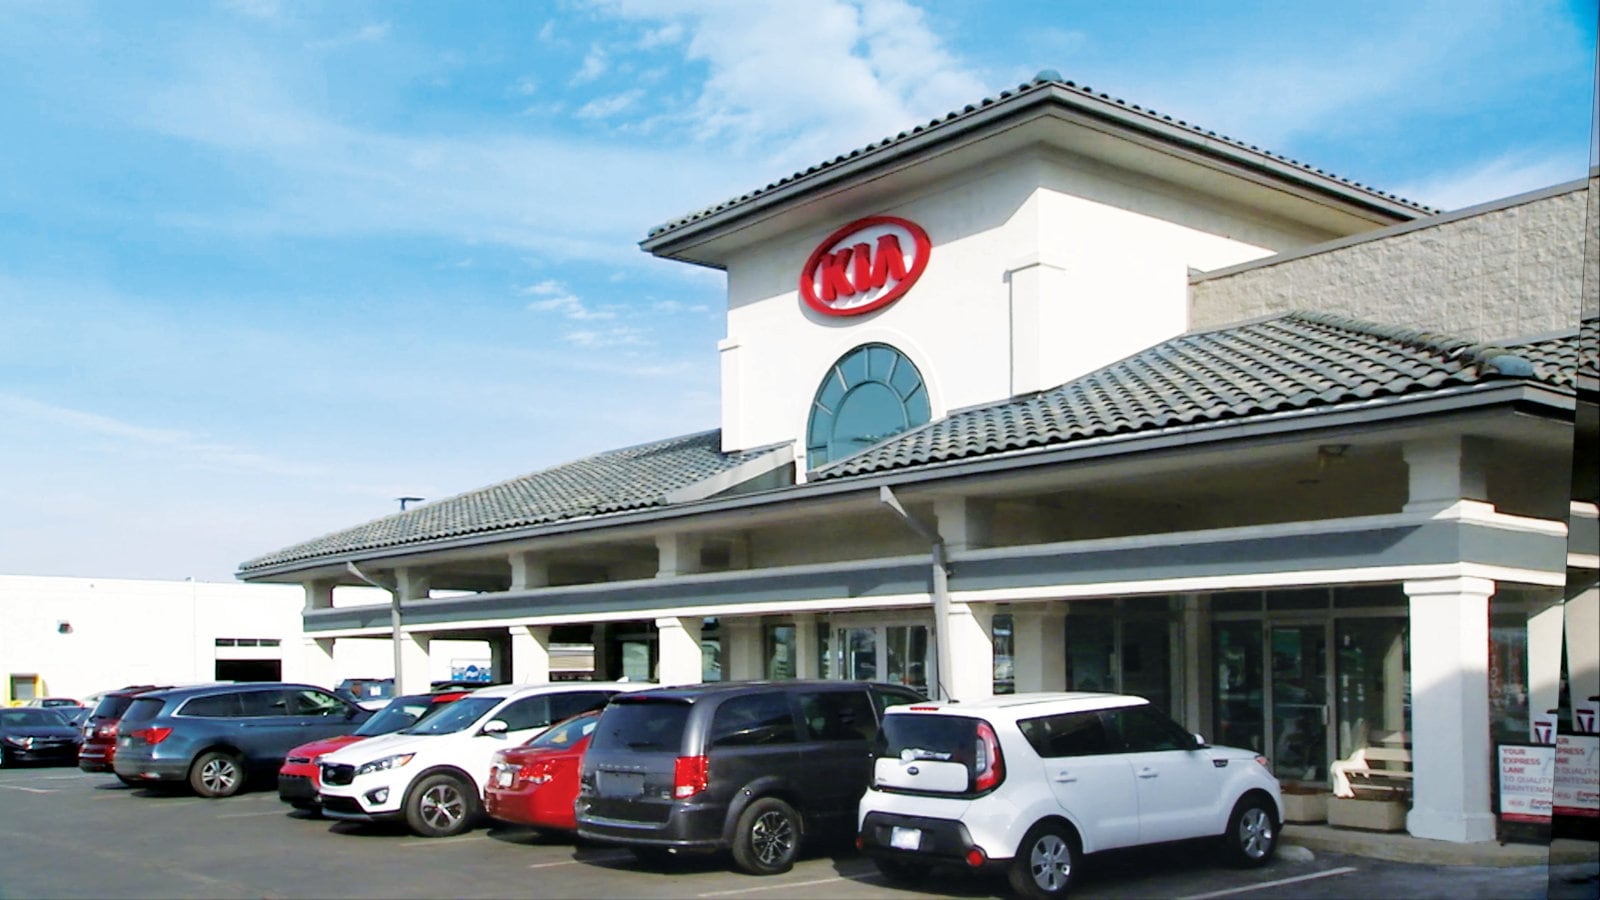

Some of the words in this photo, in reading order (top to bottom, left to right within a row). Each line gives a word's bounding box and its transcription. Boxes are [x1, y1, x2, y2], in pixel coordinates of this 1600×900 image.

[821, 233, 907, 302] KIA
[1503, 757, 1541, 765] EXPRESS
[1503, 766, 1525, 774] LANE
